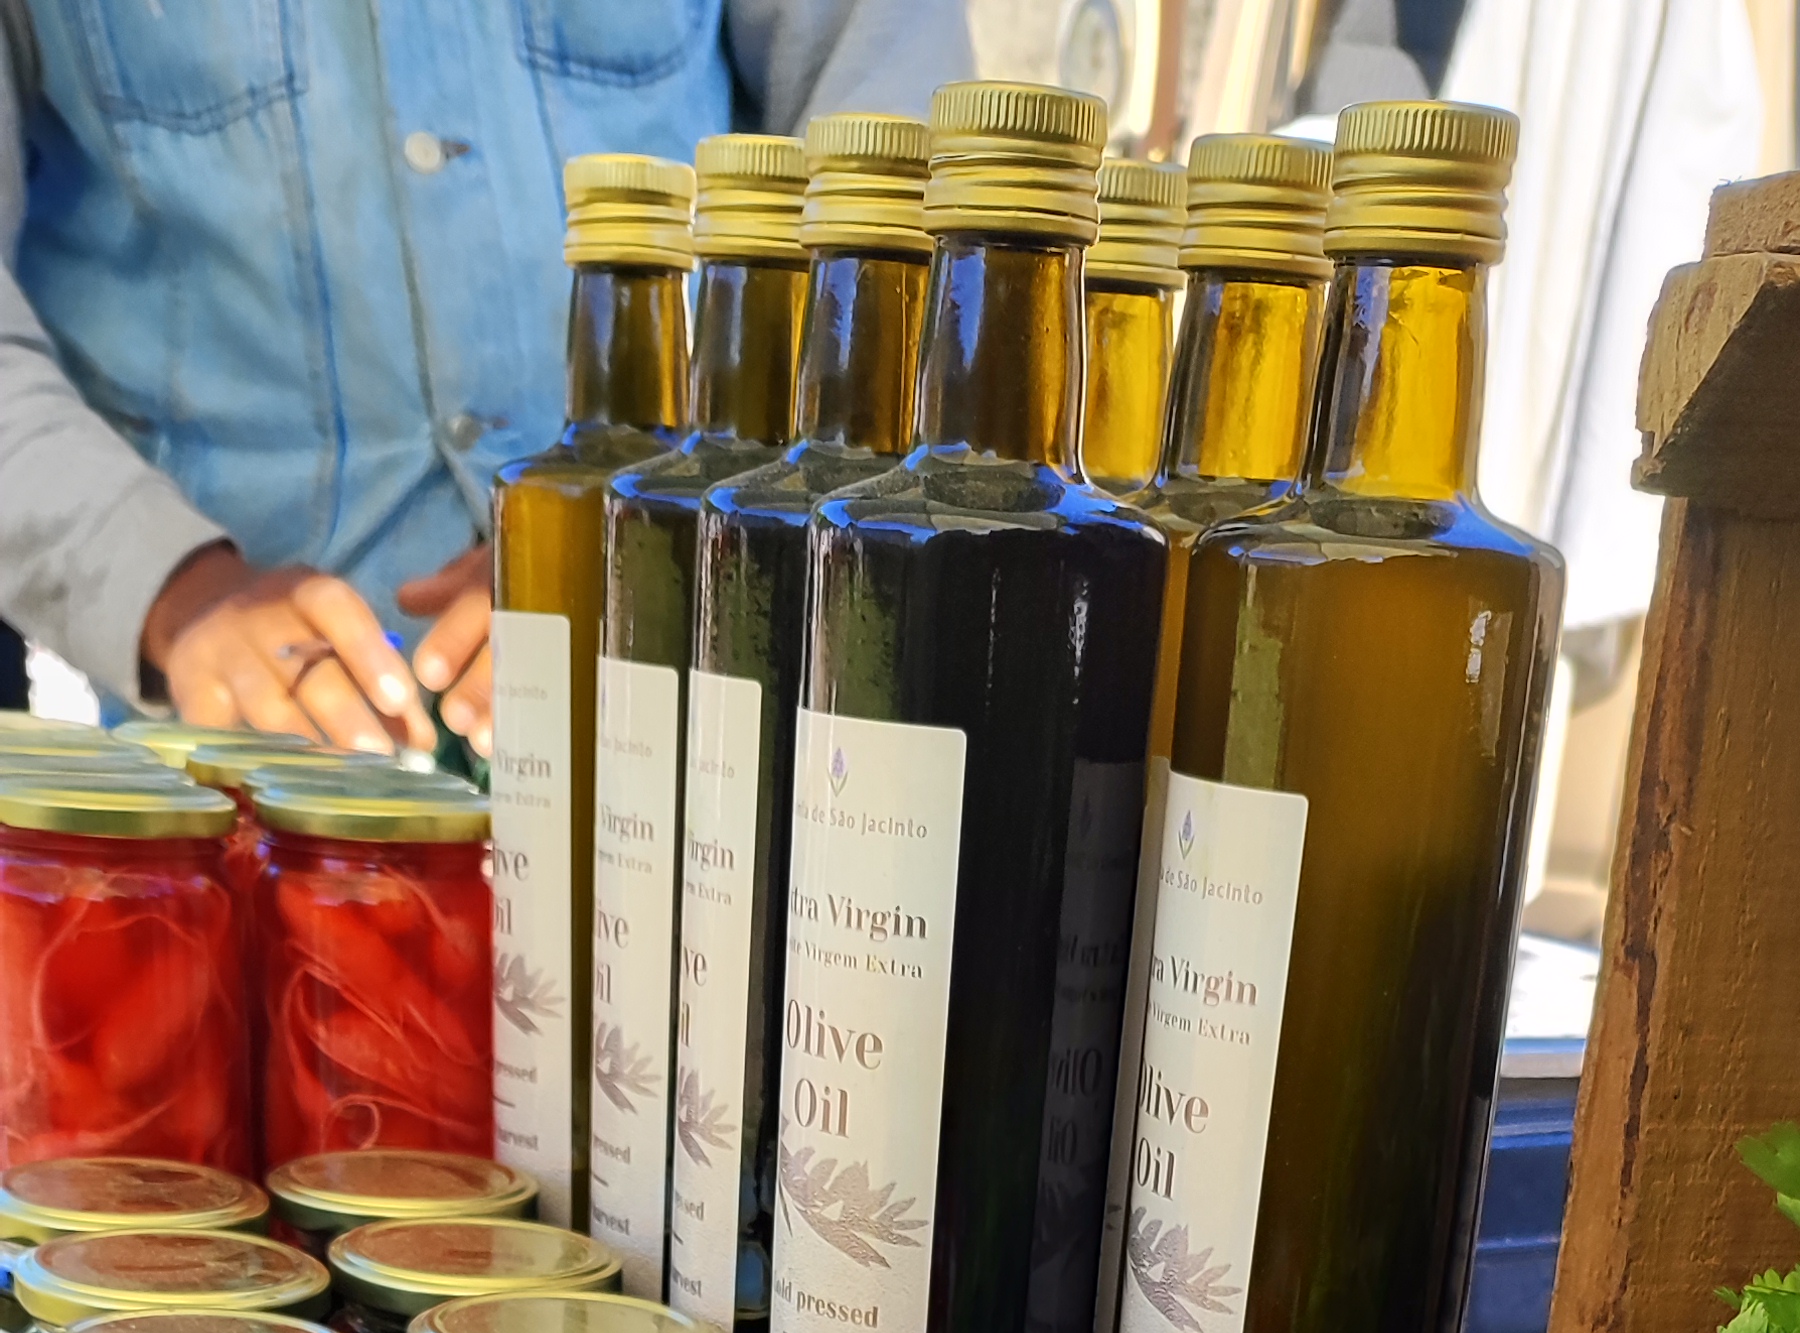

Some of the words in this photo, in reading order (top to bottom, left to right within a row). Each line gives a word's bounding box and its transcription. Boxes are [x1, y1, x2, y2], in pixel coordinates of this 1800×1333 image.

[496, 747, 551, 783] Virgin
[600, 801, 655, 844] Virgin
[829, 806, 856, 830] São
[861, 812, 928, 839] Jacinto
[1176, 869, 1199, 893] São
[1202, 876, 1264, 906] Jacinto
[826, 892, 928, 943] Virgin
[804, 940, 858, 969] Virgem
[865, 953, 923, 980] Extra
[1151, 954, 1166, 984] ra
[1170, 954, 1259, 1008] Virgin
[786, 998, 884, 1071] Olive
[1198, 1017, 1251, 1047] Extra
[793, 1077, 850, 1140] Oil
[1137, 1136, 1174, 1202] Oil
[796, 1290, 879, 1329] pressed
